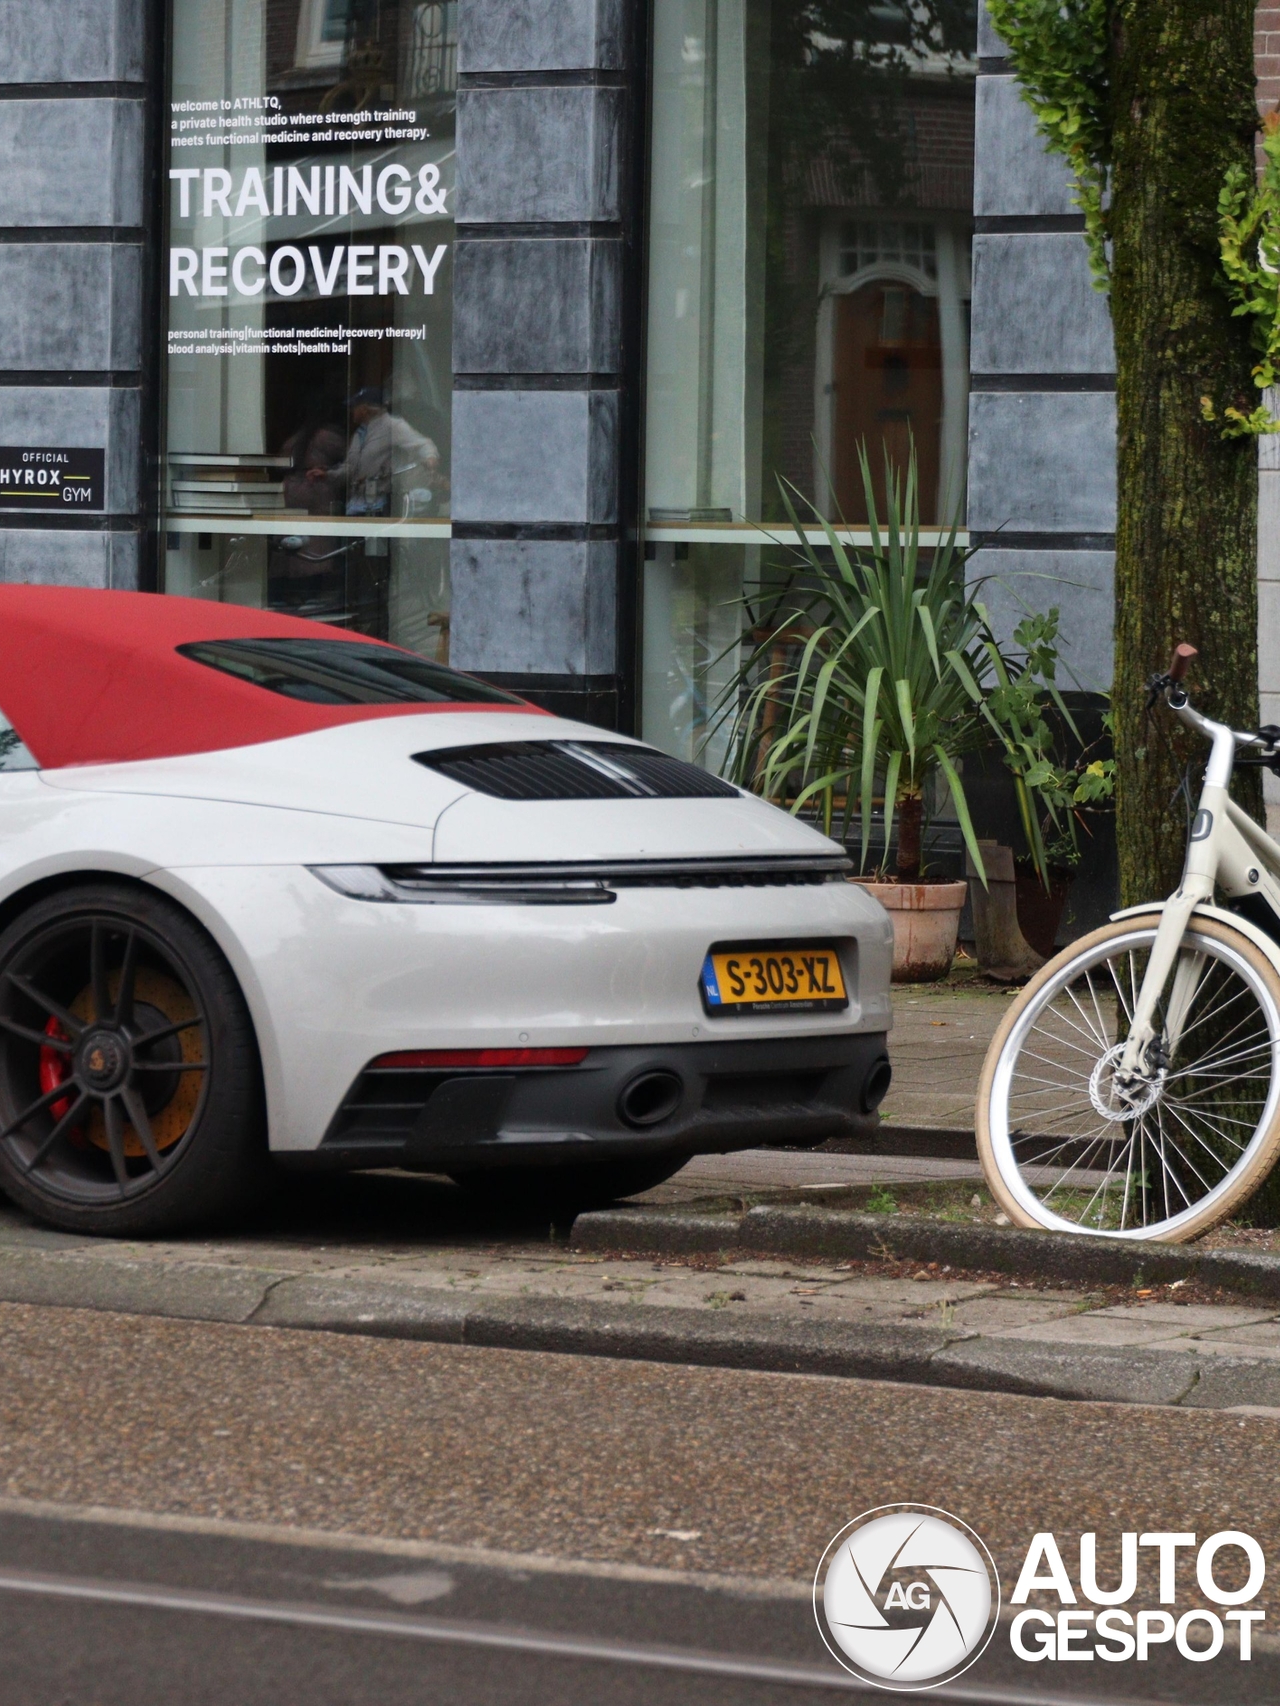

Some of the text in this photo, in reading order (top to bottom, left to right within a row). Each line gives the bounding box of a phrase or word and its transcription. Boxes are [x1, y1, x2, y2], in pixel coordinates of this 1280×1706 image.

[170, 96, 282, 113] welcome to ATHLTQ,
[170, 108, 417, 132] a private health studio where strength training
[170, 126, 431, 147] meets functional medicine and recovery therapy.
[168, 163, 449, 218] TRAINING&
[168, 244, 448, 298] RECOVERY
[167, 328, 208, 342] personal
[167, 343, 194, 354] blood
[22, 452, 70, 463] OFFICIAL
[0, 468, 61, 485] HYROX
[62, 487, 92, 502] GYM
[726, 956, 836, 997] S-303-XZ
[706, 985, 719, 997] NL
